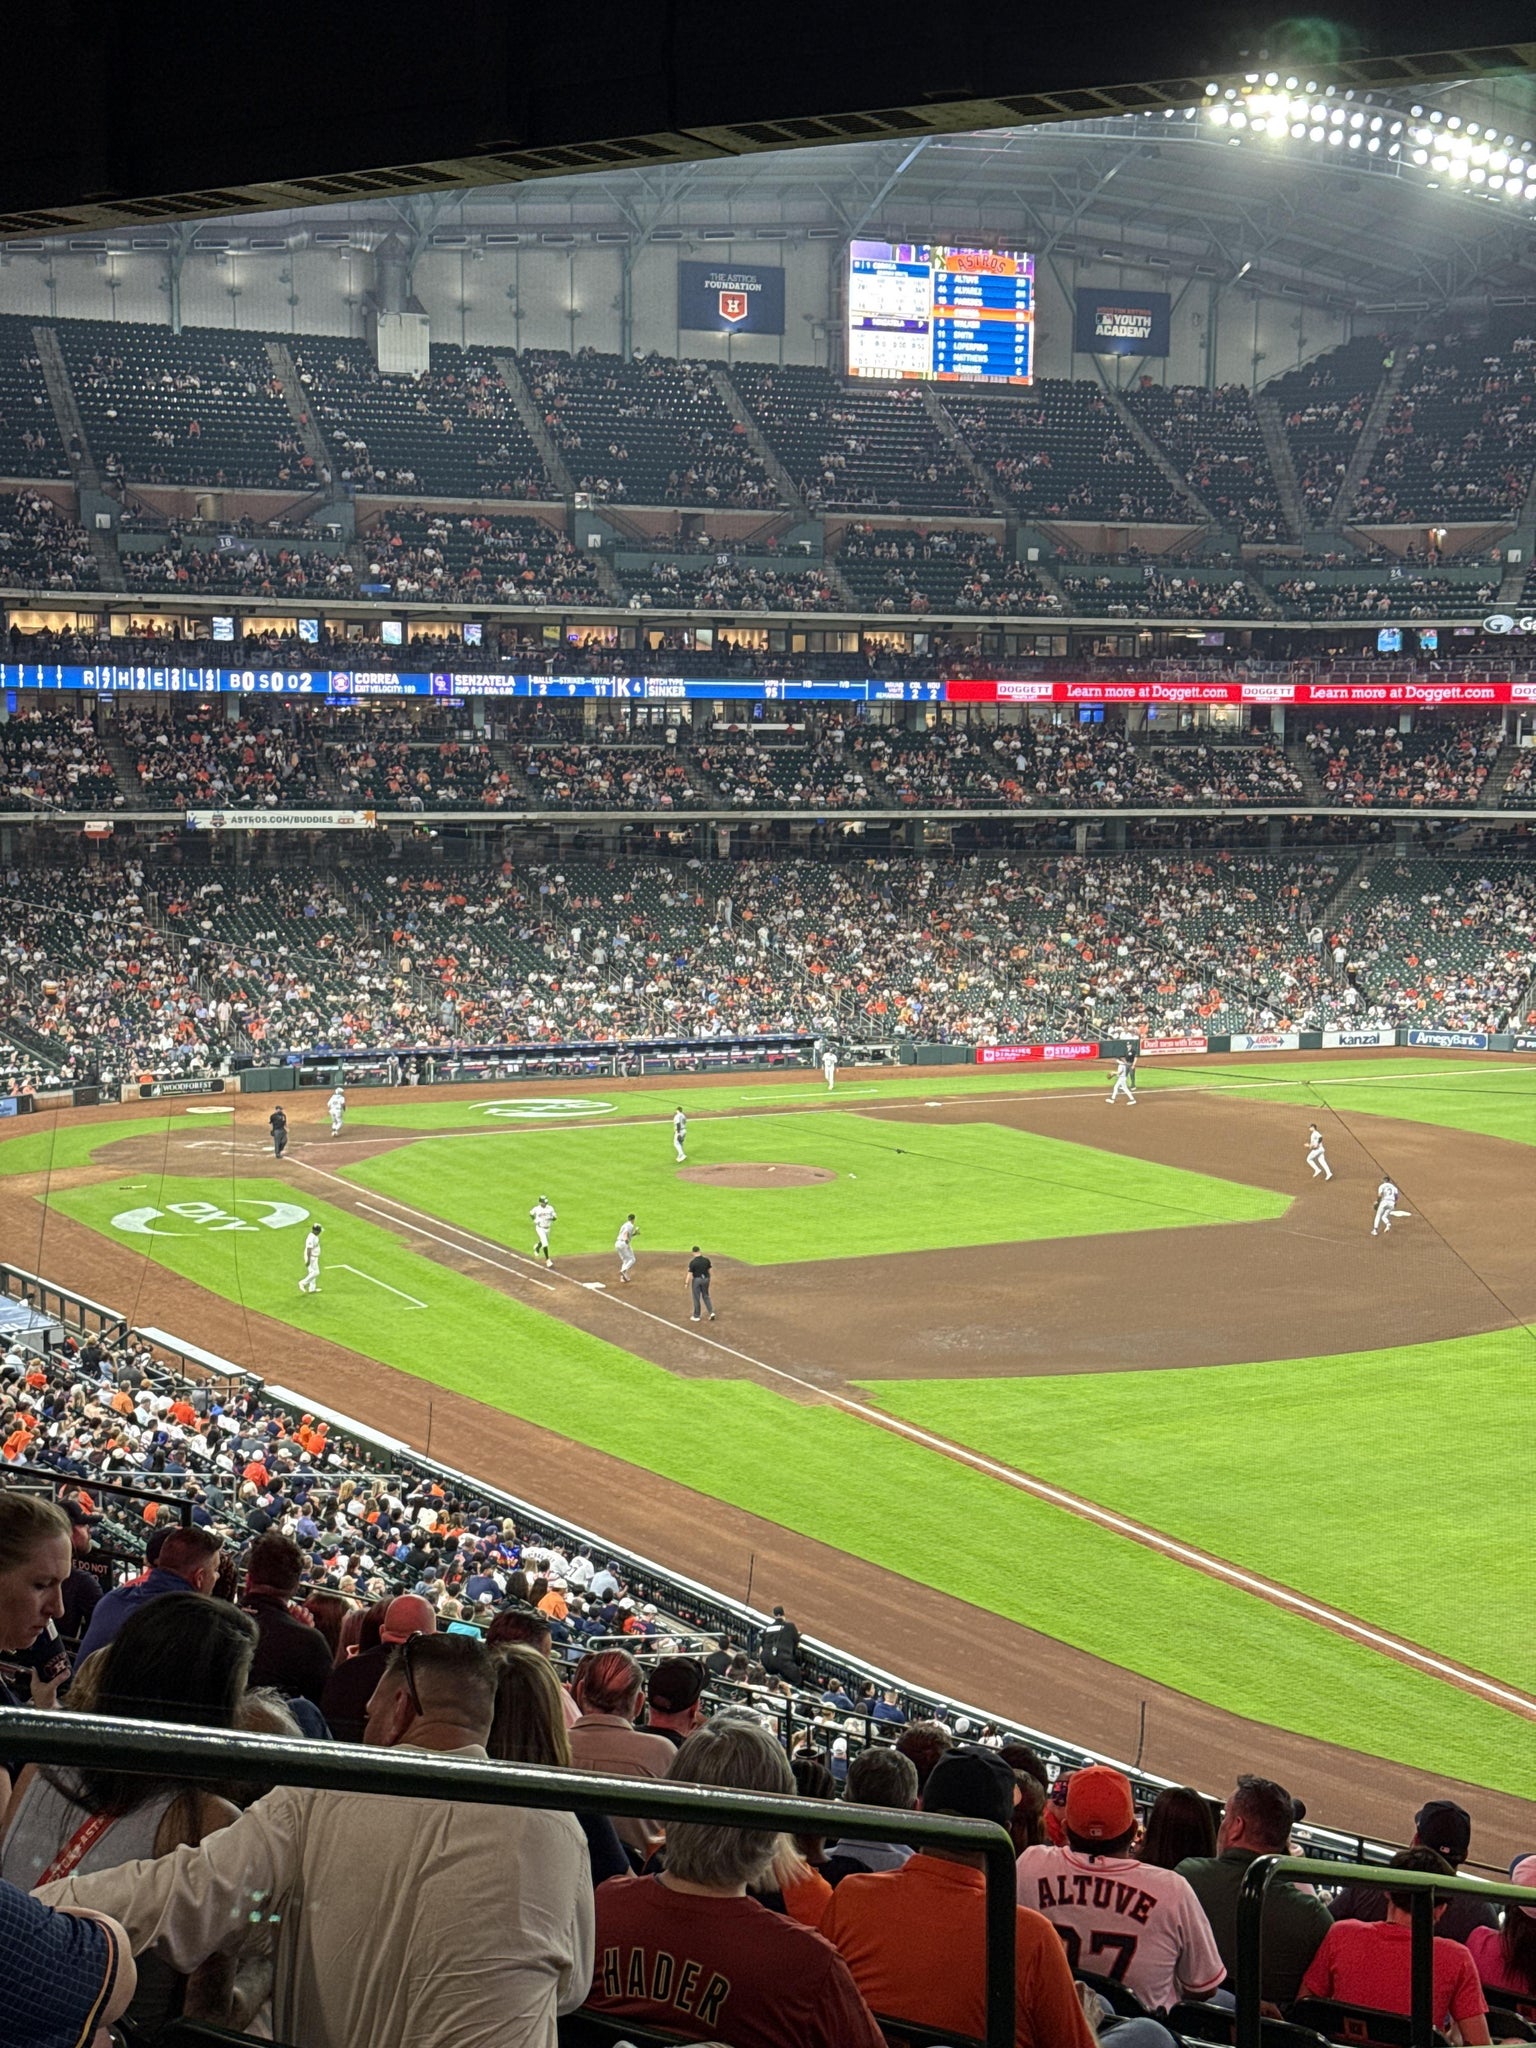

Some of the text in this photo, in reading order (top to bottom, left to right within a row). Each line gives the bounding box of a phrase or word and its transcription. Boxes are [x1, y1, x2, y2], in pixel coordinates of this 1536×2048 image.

[958, 255, 1006, 273] ASTROS
[710, 273, 757, 283] THE ASTROS
[704, 280, 762, 291] FOUNDATION
[1114, 314, 1152, 327] YOUTH
[1095, 325, 1152, 338] ACADEMY
[220, 537, 232, 547] 18
[717, 555, 728, 565] 20
[83, 670, 94, 686] R
[118, 671, 129, 686] H
[154, 672, 164, 686] E
[189, 673, 198, 687] L
[230, 673, 240, 688] B
[242, 671, 255, 691] 0
[259, 674, 270, 688] S
[271, 672, 284, 691] 0
[299, 672, 312, 692] 2
[354, 673, 400, 684] CORREA
[455, 674, 516, 687] SENZATELA
[533, 676, 553, 684] BALLS
[559, 676, 585, 685] STRIKES
[591, 677, 611, 685] TOTAL
[649, 678, 684, 686] PITCH TYPE
[355, 685, 370, 693] EXIT
[539, 685, 547, 695] 2
[568, 685, 576, 696] 9
[595, 685, 606, 696] 11
[617, 678, 631, 697] K
[648, 686, 686, 697] SINKER
[999, 685, 1050, 693] DOGGETT
[911, 689, 919, 699] 2
[930, 689, 938, 699] 2
[1067, 685, 1228, 702] Learn more at Doggett.com
[1309, 686, 1495, 702] Learn more at Doggett.com
[230, 815, 333, 825] ASTROS.COM/BUDDIES
[1174, 1039, 1187, 1047] with
[1255, 1036, 1279, 1044] ARROW
[1339, 1032, 1380, 1045] kanzal
[1055, 1046, 1090, 1055] STRAUSS
[162, 1081, 213, 1091] WOODFOREST
[166, 1201, 260, 1231] OXY
[78, 1560, 90, 1570] DO
[91, 1563, 109, 1574] NOT
[1038, 1875, 1158, 1925] ALTUVE
[603, 1947, 731, 2029] HADER
